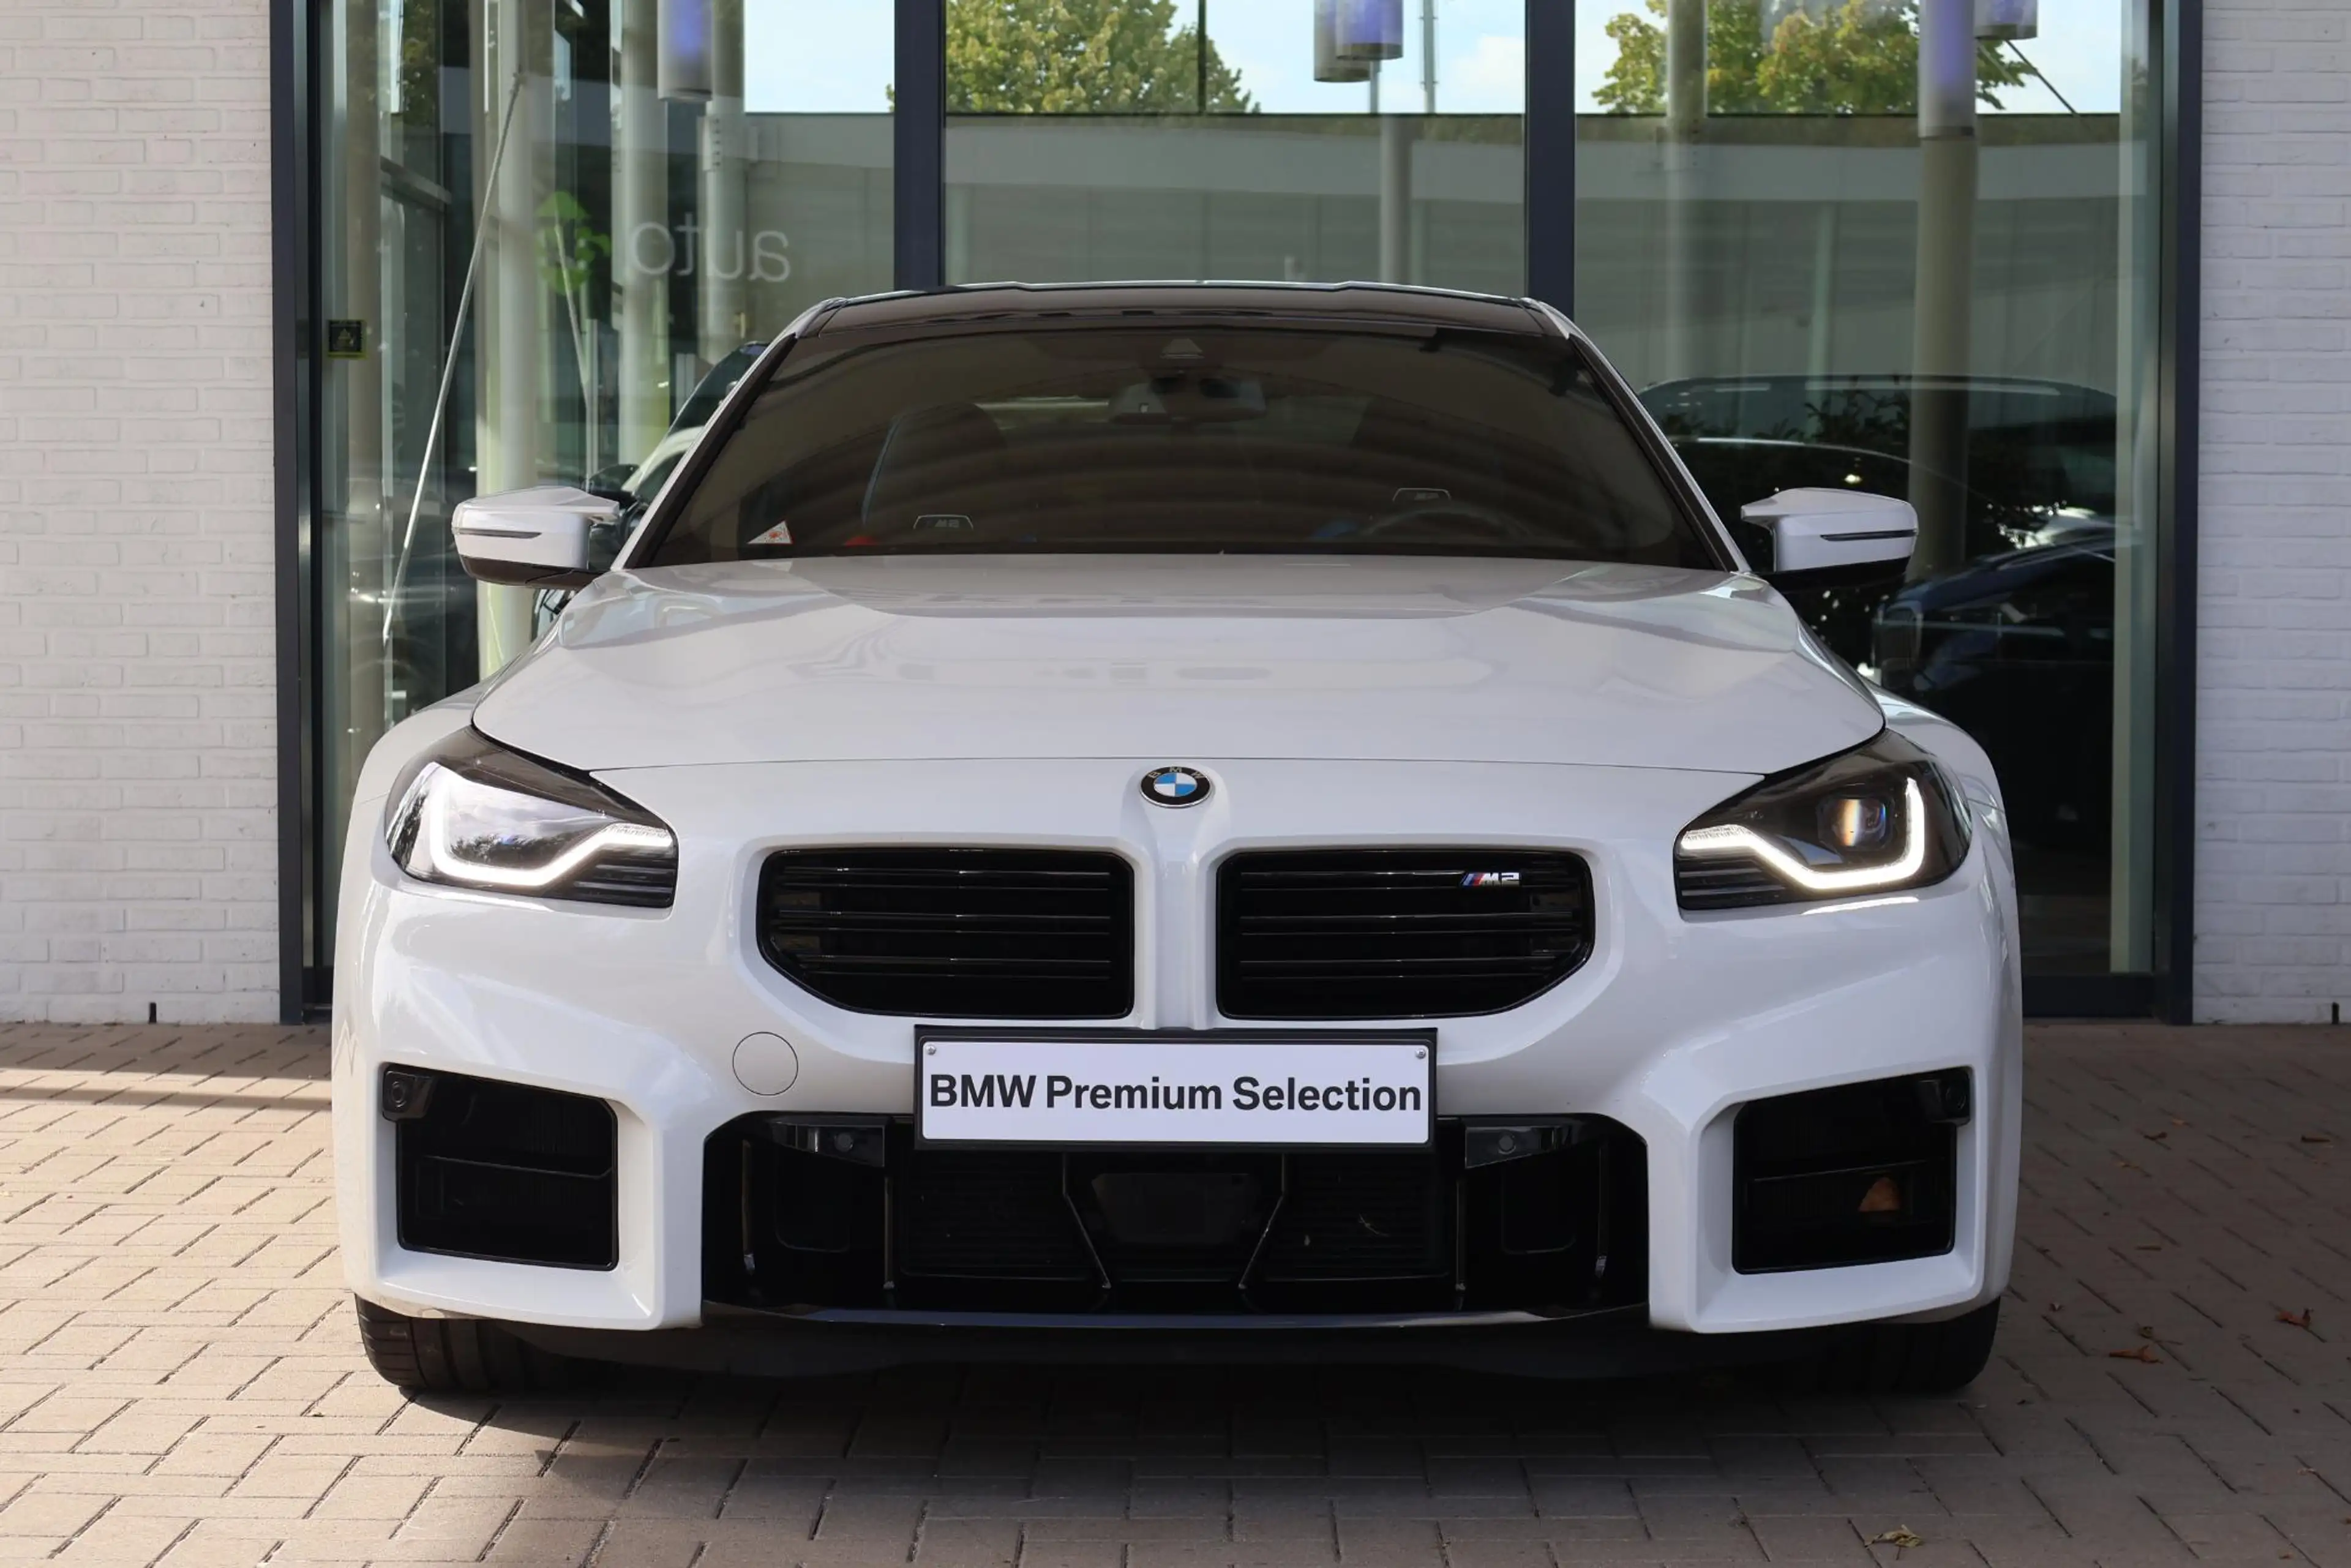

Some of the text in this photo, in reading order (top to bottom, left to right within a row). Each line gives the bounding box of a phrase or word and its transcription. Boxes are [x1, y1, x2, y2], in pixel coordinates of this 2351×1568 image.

[1147, 766, 1206, 779] BMW
[1479, 872, 1520, 887] M2
[930, 1074, 1421, 1111] BMW Premium Selection
